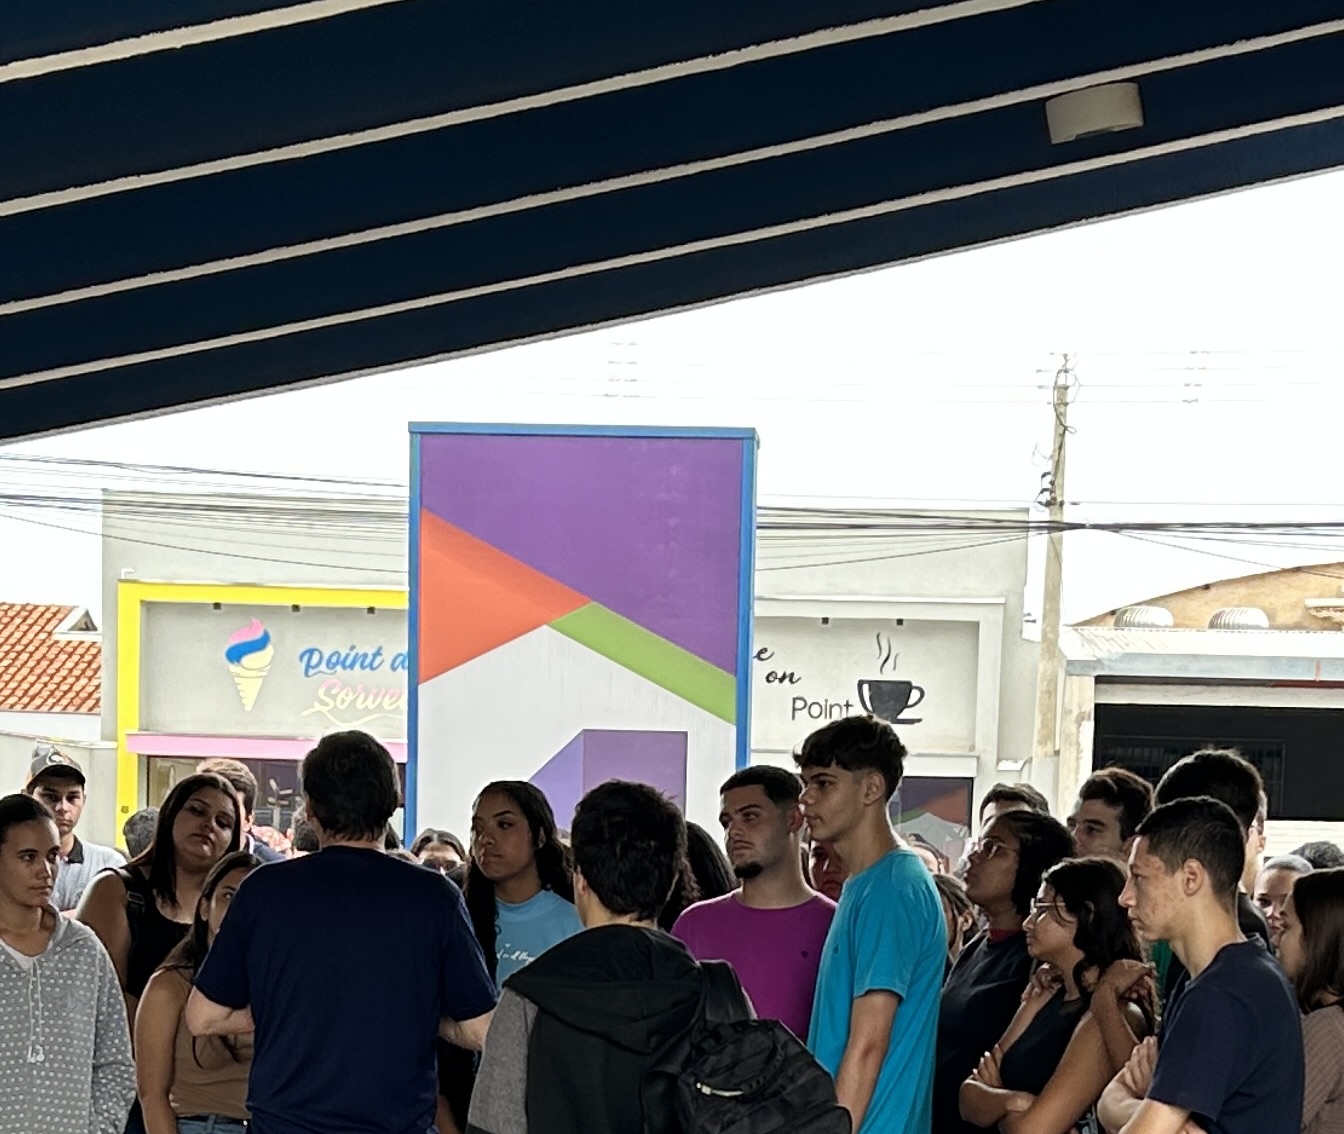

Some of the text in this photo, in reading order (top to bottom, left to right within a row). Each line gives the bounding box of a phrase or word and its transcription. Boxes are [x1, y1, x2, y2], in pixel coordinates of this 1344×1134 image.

[299, 645, 385, 678] Point
[766, 669, 802, 684] on
[301, 678, 408, 712] Sorve
[791, 696, 854, 720] Point
